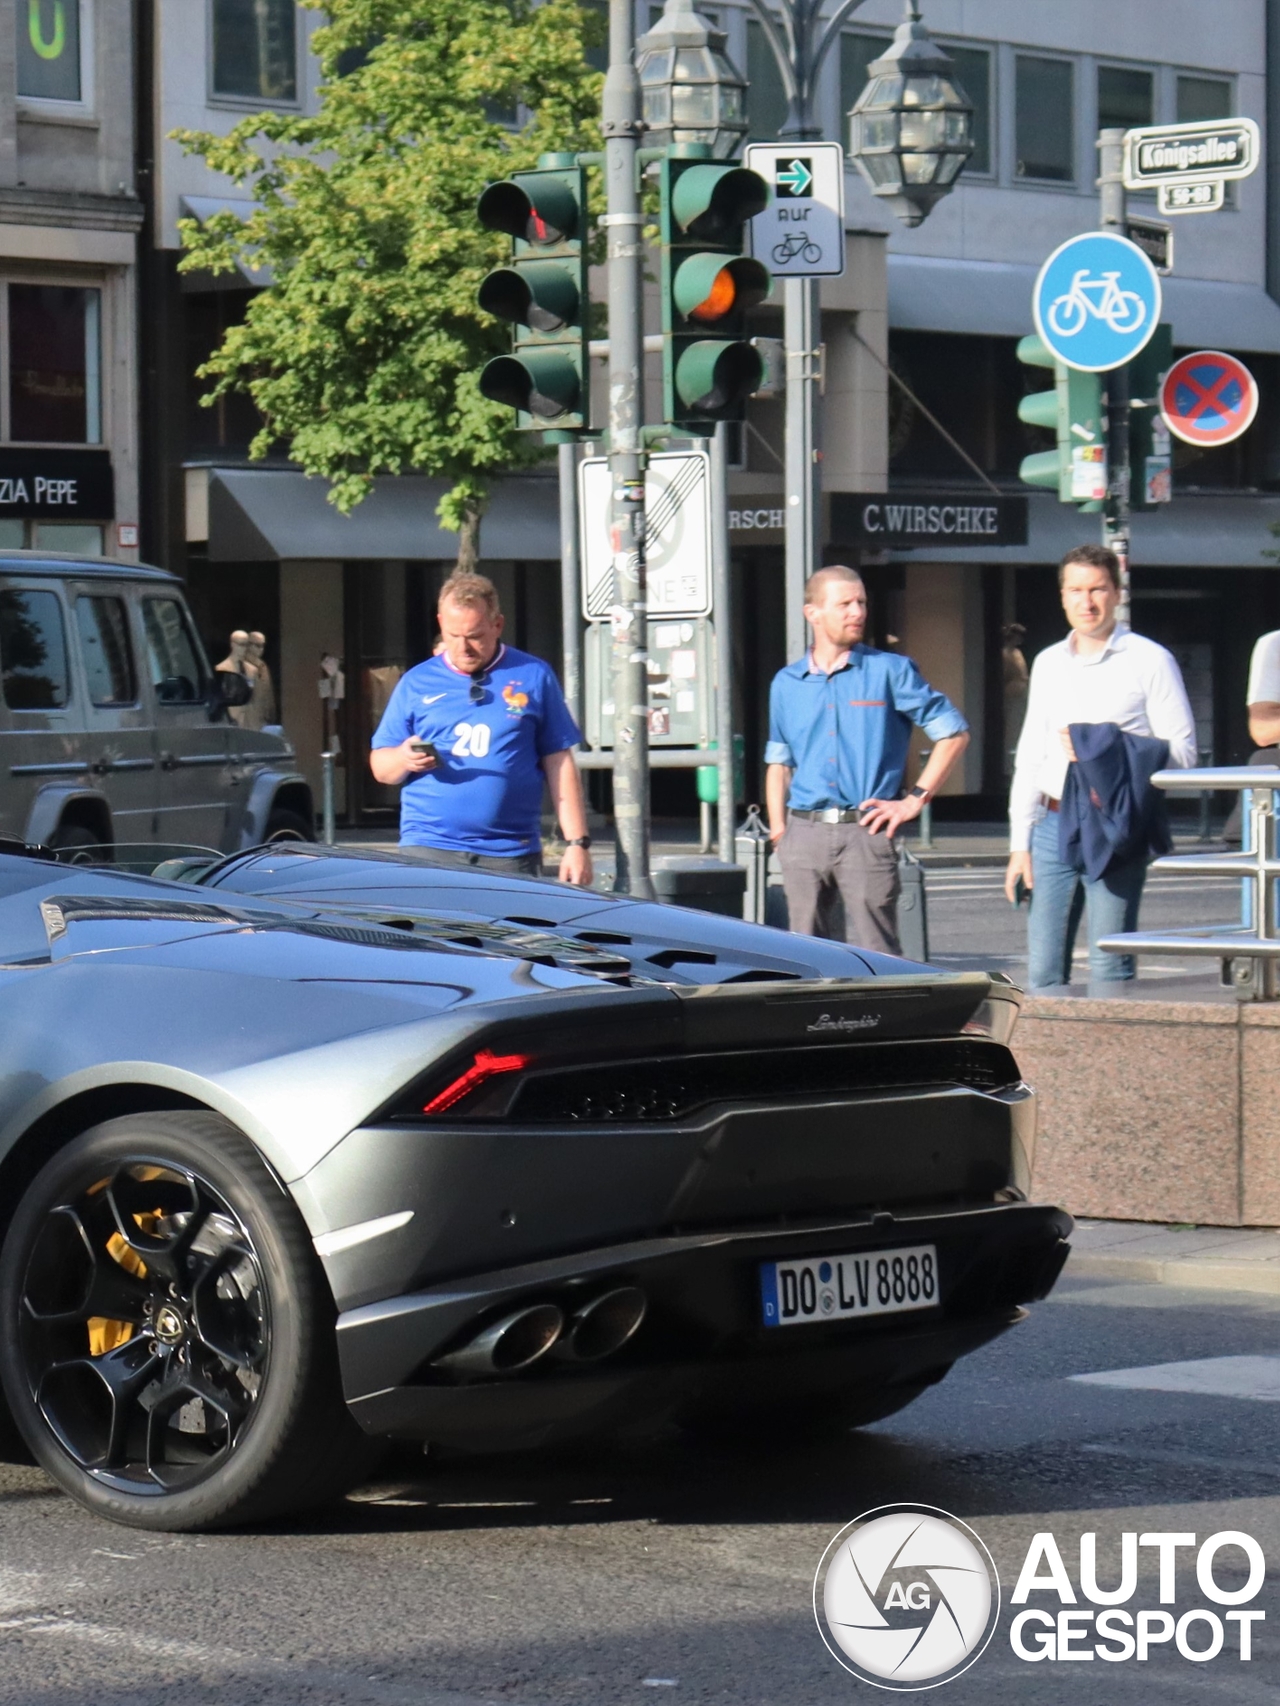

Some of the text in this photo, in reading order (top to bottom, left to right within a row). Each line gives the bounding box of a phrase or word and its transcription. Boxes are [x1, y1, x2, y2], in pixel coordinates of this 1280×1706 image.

[1141, 137, 1237, 170] Königsallee
[34, 476, 78, 505] PEPE
[862, 504, 999, 534] C.WIRSCHKE
[451, 722, 491, 758] 20
[780, 1266, 818, 1318] DO
[837, 1259, 870, 1310] LV
[876, 1252, 936, 1306] 8888
